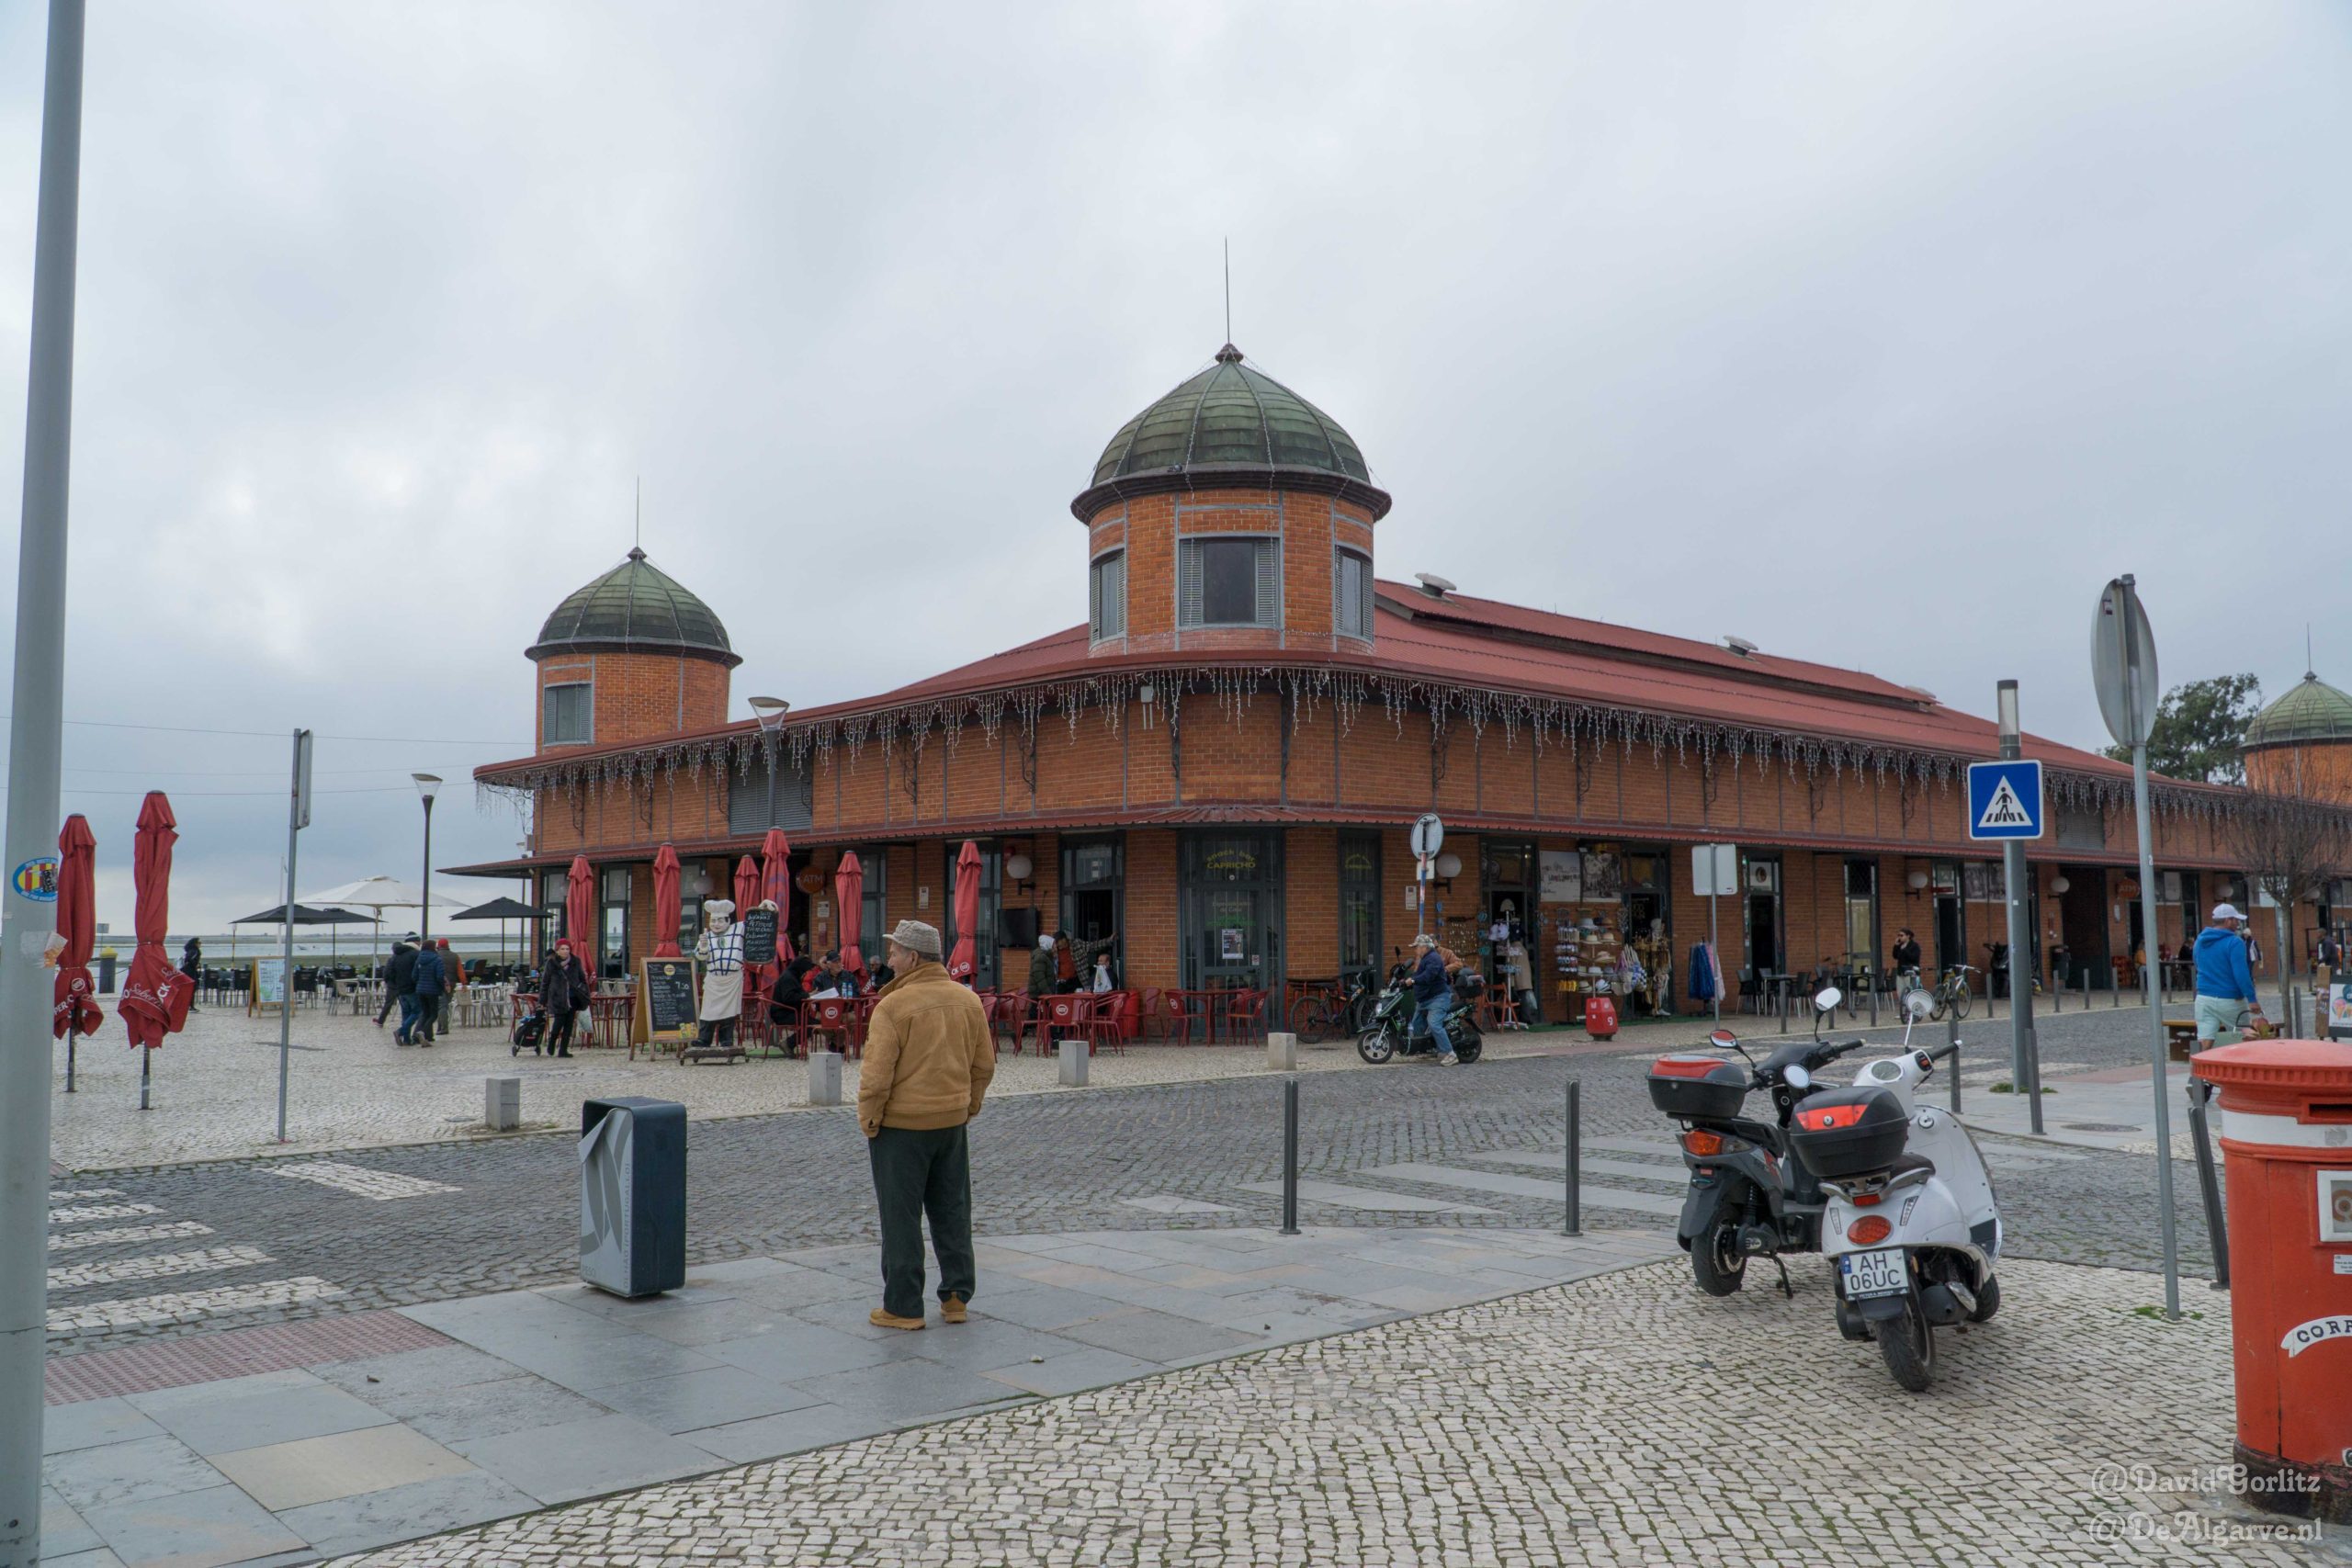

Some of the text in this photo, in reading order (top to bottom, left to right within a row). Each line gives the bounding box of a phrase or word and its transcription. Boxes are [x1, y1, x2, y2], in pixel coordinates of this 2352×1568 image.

[804, 874, 823, 883] ATM
[1859, 1252, 1888, 1272] AH
[1849, 1269, 1901, 1292] 06UC
